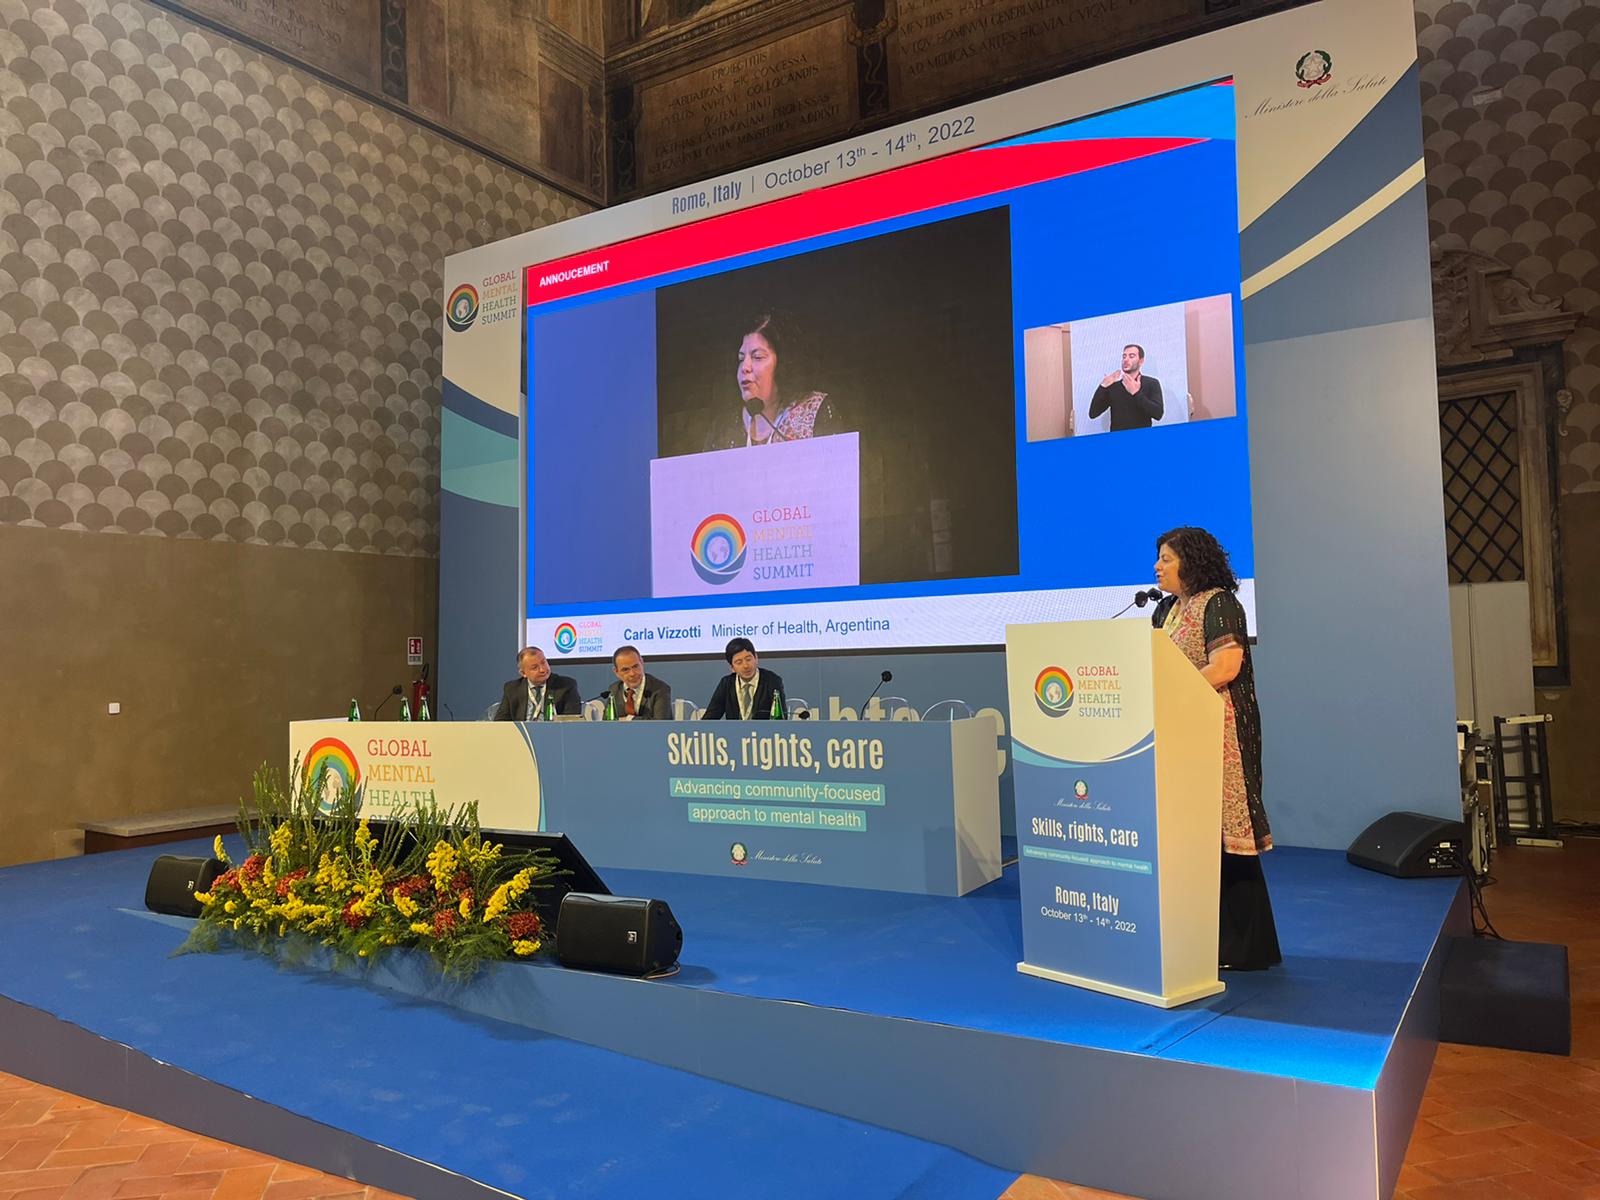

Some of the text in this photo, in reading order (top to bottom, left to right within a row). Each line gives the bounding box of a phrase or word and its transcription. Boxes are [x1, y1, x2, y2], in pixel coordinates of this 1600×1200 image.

[1244, 75, 1388, 118] Ministero della Salute
[671, 189, 709, 215] Rome,
[712, 178, 742, 207] Italy
[764, 160, 829, 190] October
[837, 145, 867, 170] 13th
[928, 116, 976, 146] 2022
[482, 270, 517, 288] GLOBAL
[539, 261, 609, 286] ANNOUCEMENT
[482, 284, 518, 300] MENTAL
[482, 295, 517, 313] HEALTH
[481, 308, 517, 325] SUMMIT
[752, 505, 812, 524] GLOBAL
[753, 525, 813, 543] MENTAL
[753, 543, 813, 562] HEALTH
[753, 563, 815, 580] SUMMIT
[623, 617, 890, 641] Carla Vizzotti Minister of Health, Argentina
[1077, 666, 1119, 676] GLOBAL
[1078, 680, 1122, 690] MENTAL
[1078, 694, 1121, 704] HEALTH
[1078, 707, 1122, 718] SUMMIT
[367, 738, 432, 757] GLOBAL
[667, 731, 884, 774] Skills, rights, care
[368, 764, 436, 783] MENTAL
[369, 789, 434, 808] HEALTH
[674, 779, 881, 804] Advancing community-focused
[692, 805, 862, 828] approach to mental health
[1031, 816, 1139, 848] Skills, rights, care
[1055, 885, 1120, 916] Rome, Italy
[1040, 906, 1072, 921] October
[1114, 920, 1137, 934] 2022
